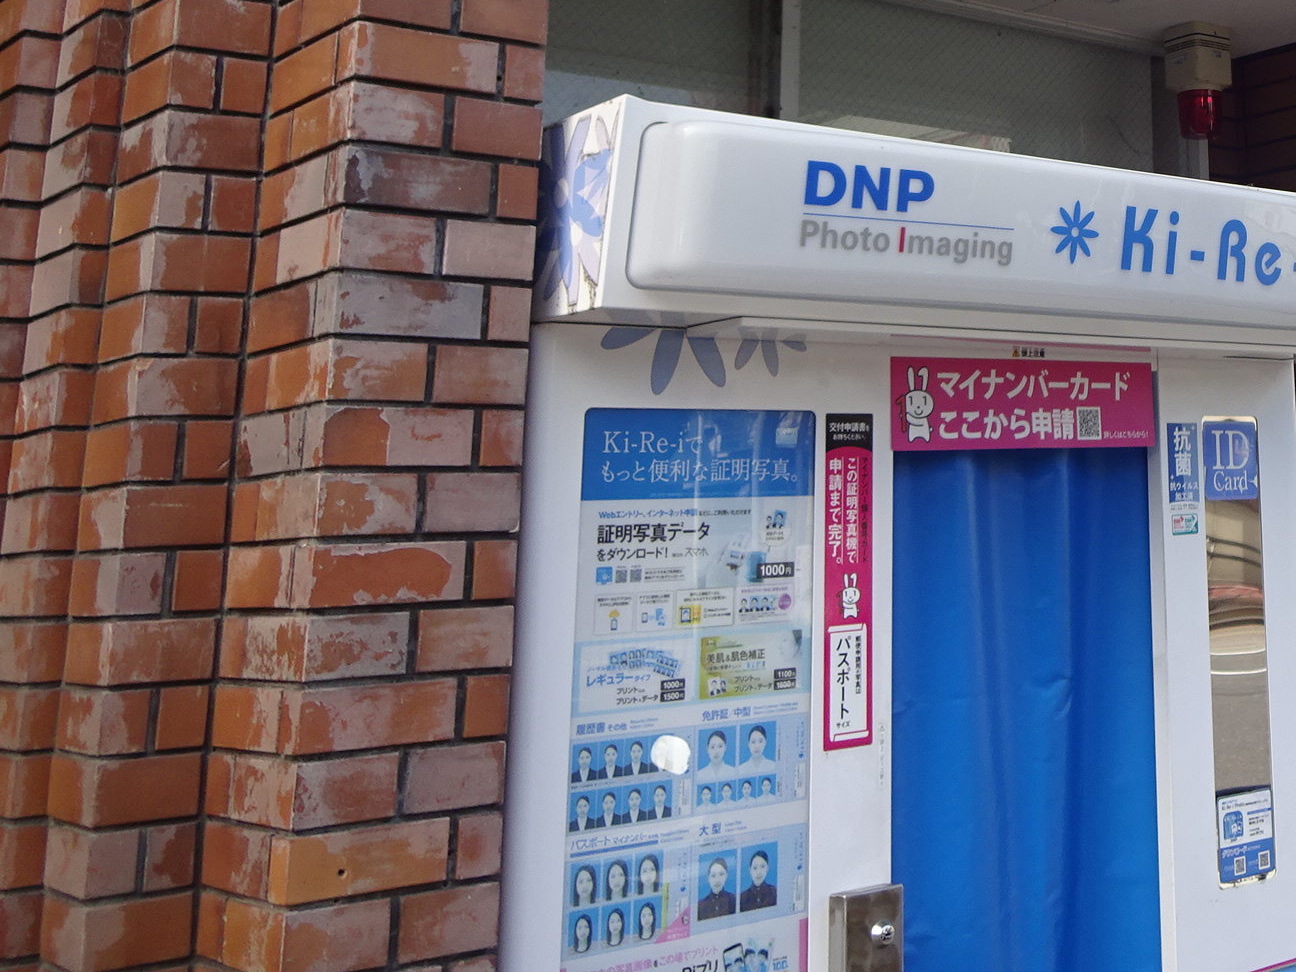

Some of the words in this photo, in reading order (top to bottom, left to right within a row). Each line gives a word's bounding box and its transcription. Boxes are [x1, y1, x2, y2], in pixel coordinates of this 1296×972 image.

[804, 160, 935, 213] DNP
[800, 219, 891, 253] Photo
[898, 226, 1014, 267] Imaging
[936, 369, 1131, 402] マイナンバーカード
[938, 407, 1076, 441] ここから申請
[1174, 426, 1192, 477] 抗菌
[1211, 430, 1251, 470] ID
[601, 458, 798, 483] もっと便利な証明写真。
[1213, 470, 1249, 492] Card
[597, 521, 711, 544] 証明写真データ
[836, 636, 852, 720] パスポート
